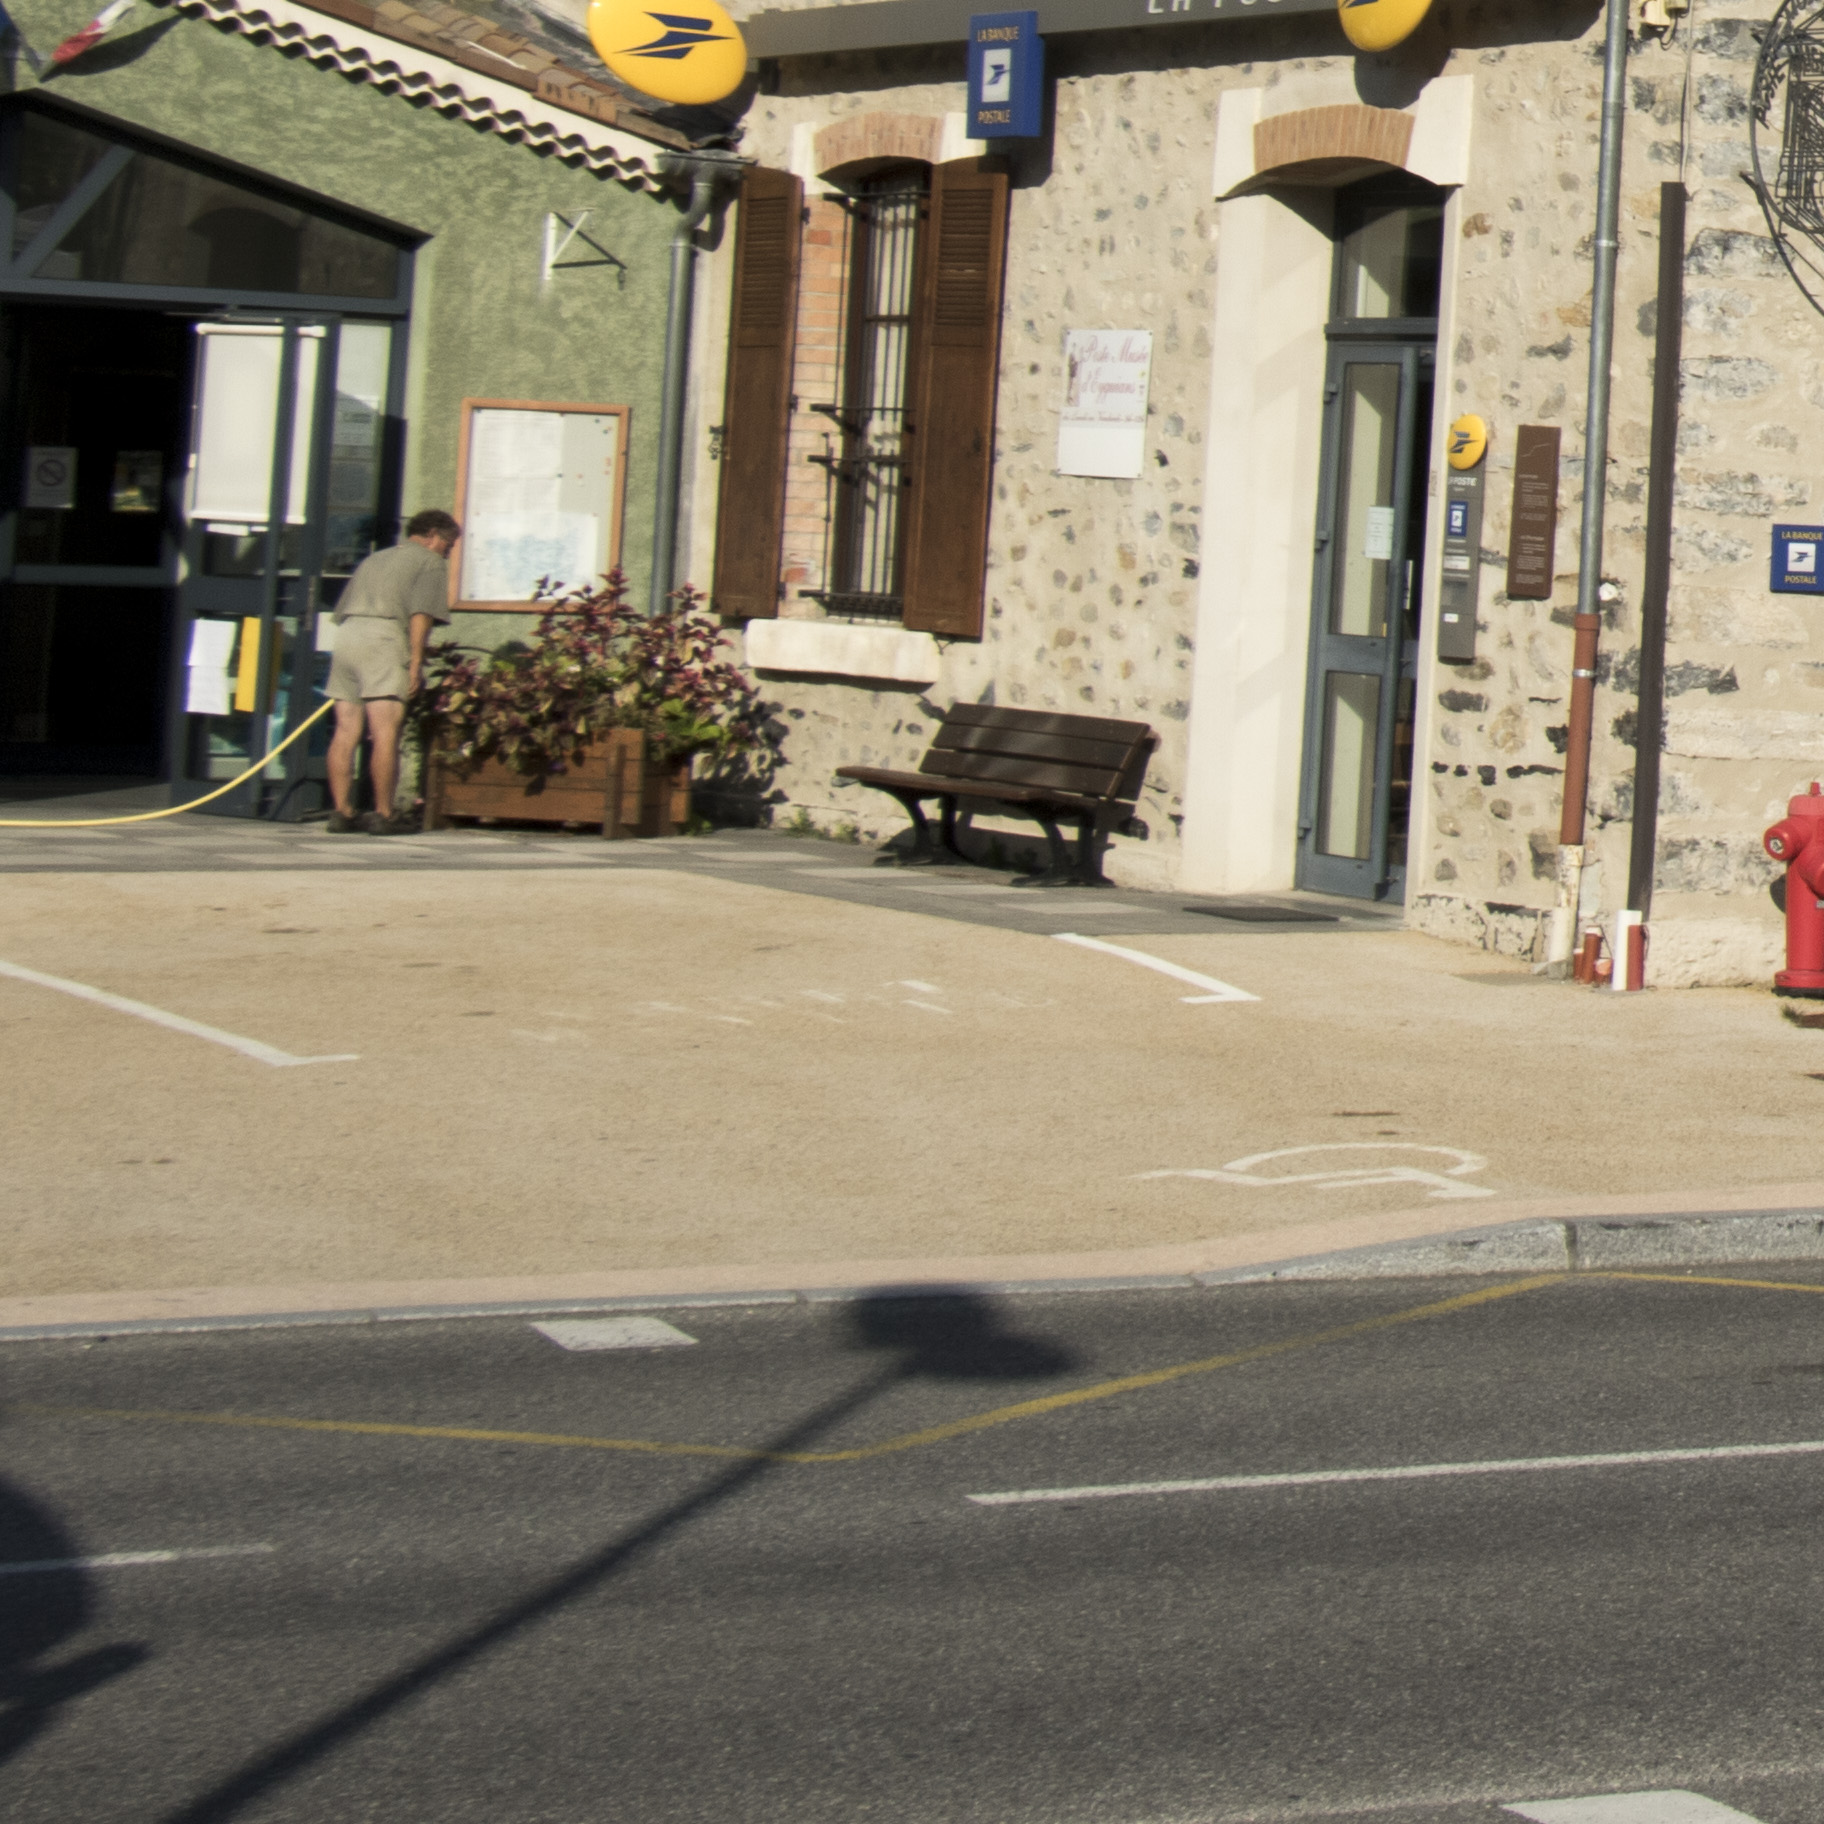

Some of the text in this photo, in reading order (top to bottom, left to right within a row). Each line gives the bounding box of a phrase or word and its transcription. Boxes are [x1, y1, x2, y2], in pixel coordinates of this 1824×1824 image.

[1782, 531, 1823, 541] LA BANQUE
[1784, 575, 1817, 585] POSTALE
